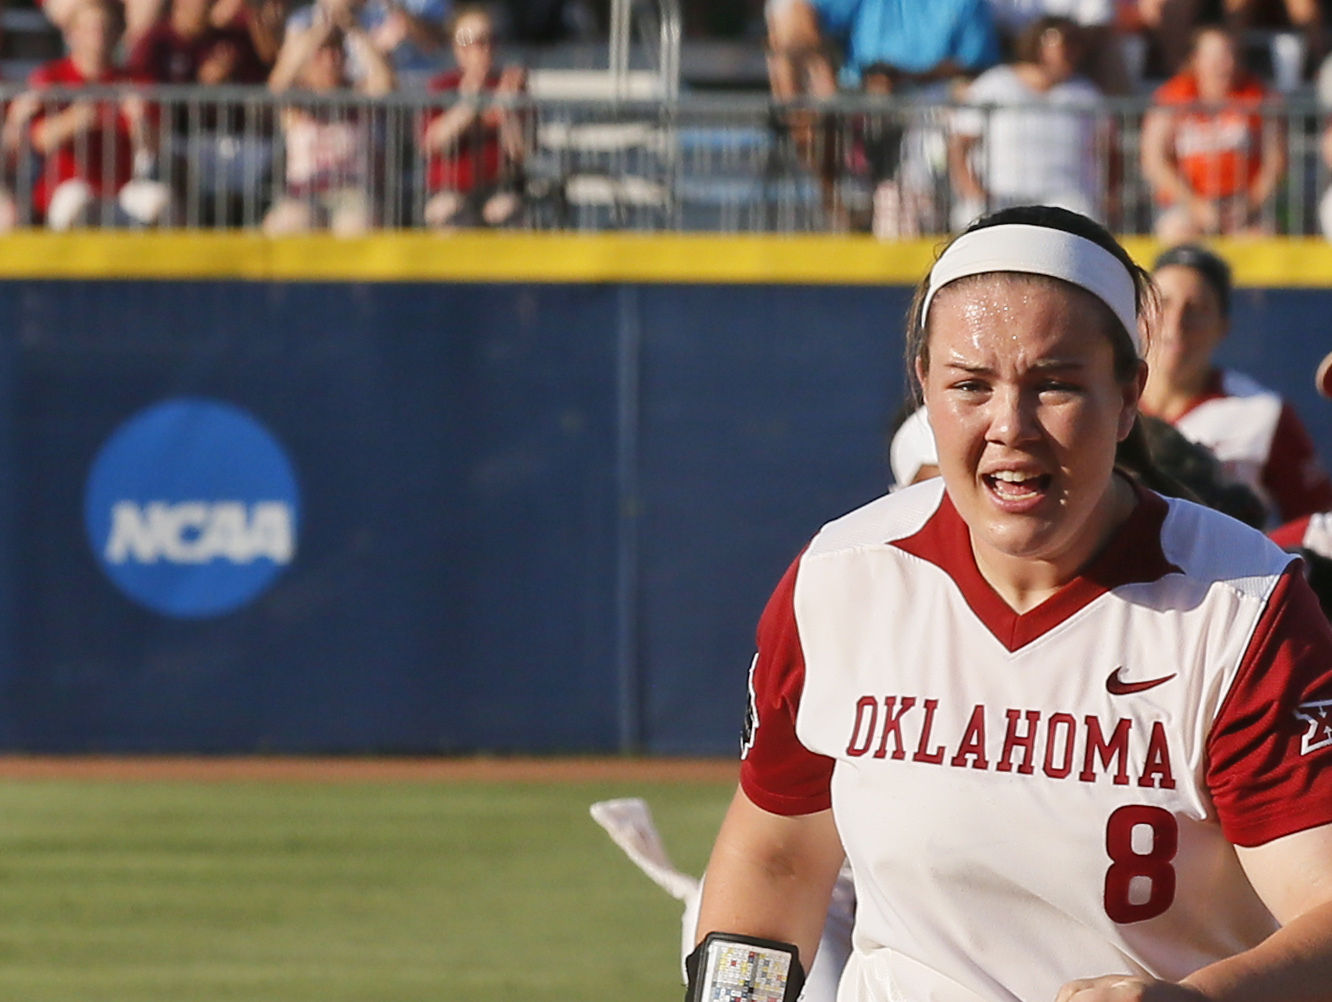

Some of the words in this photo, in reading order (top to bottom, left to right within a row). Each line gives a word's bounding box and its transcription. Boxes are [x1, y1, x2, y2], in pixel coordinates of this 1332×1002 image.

[105, 502, 293, 564] NCAA
[846, 695, 1177, 790] OKLAHOMA
[1104, 804, 1179, 924] 8
